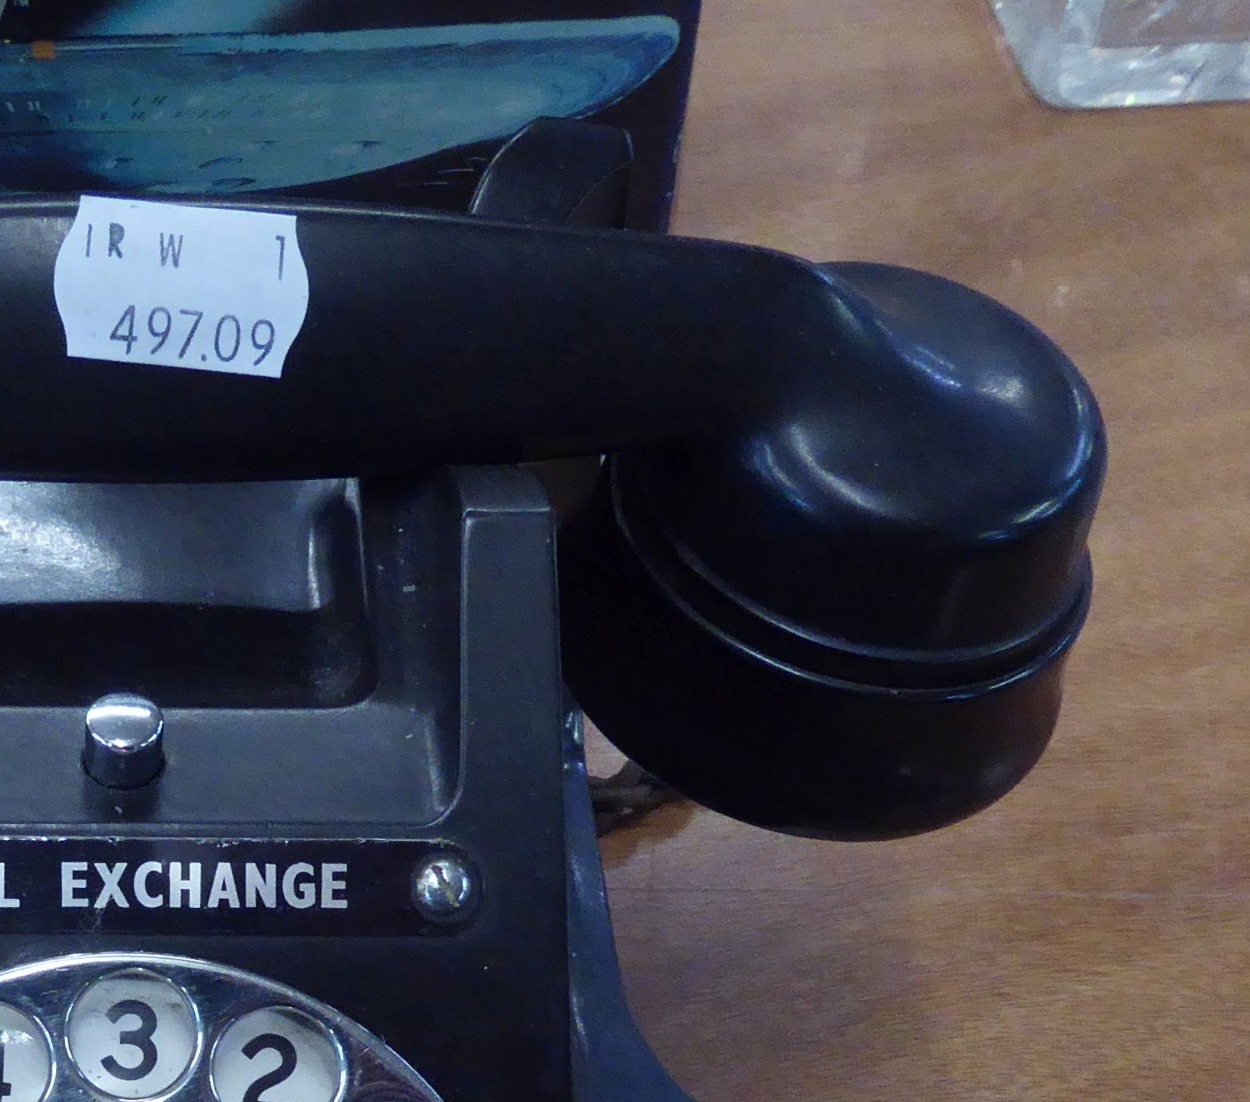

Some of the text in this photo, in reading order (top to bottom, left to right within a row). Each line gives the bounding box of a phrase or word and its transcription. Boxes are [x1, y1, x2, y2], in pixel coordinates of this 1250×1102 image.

[109, 304, 276, 367] 497.09
[60, 861, 349, 910] EXCHANGE
[100, 999, 159, 1082] 3
